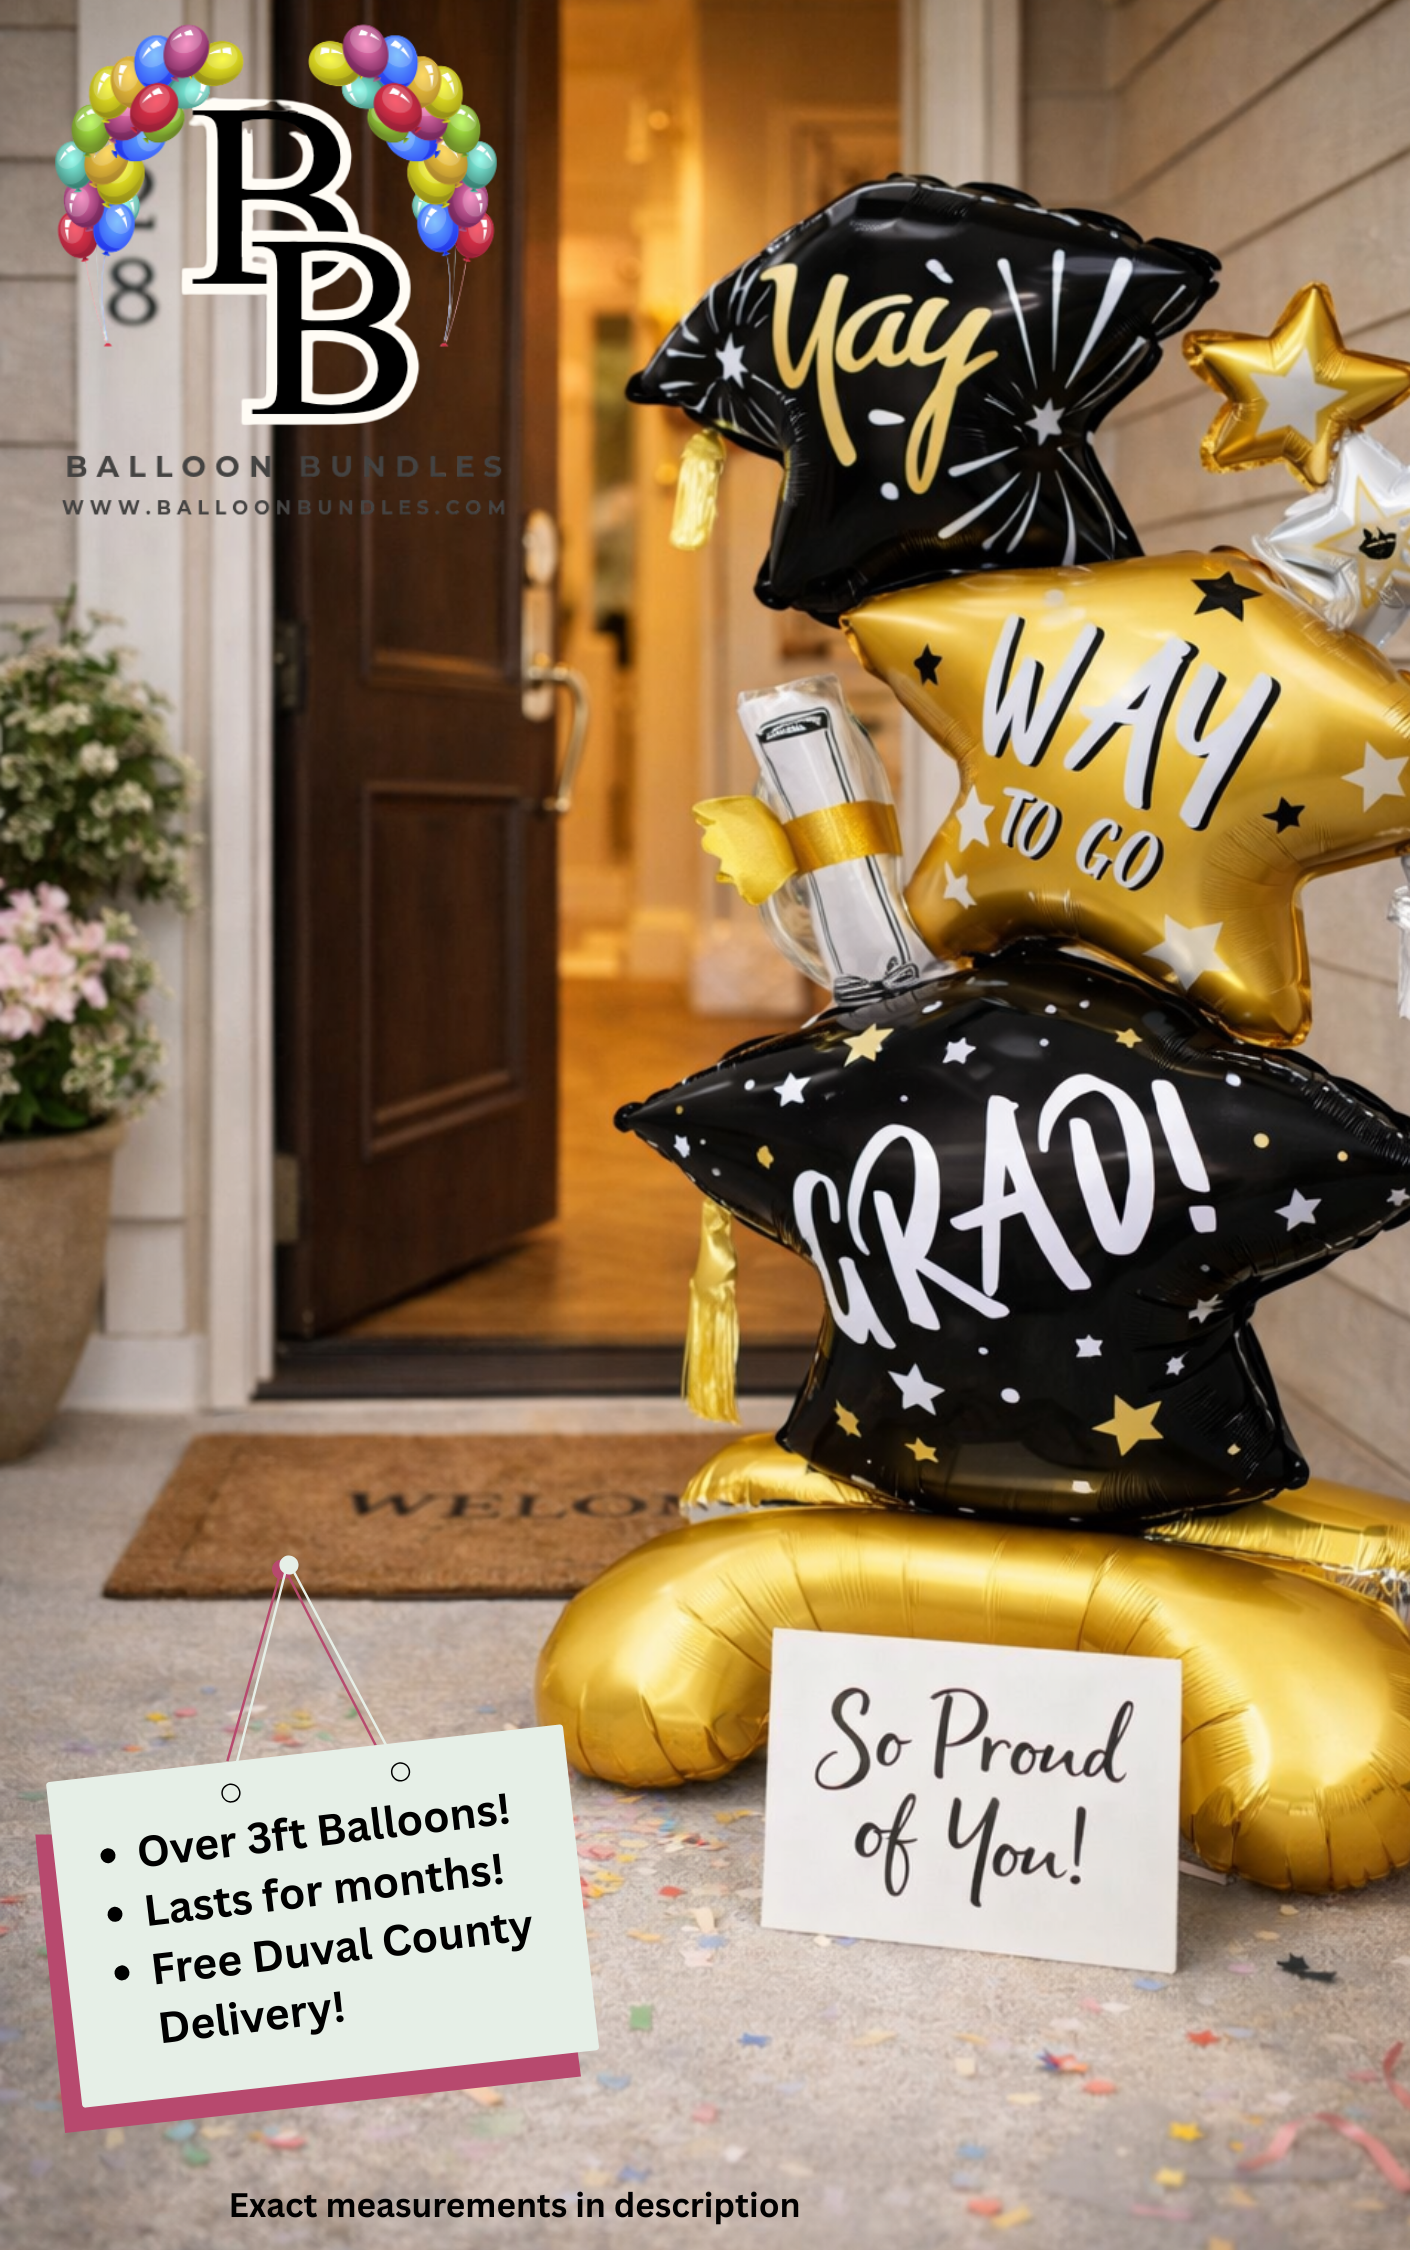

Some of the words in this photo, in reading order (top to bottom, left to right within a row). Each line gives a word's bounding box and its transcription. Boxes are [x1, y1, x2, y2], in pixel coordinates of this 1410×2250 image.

[761, 262, 998, 495] Yay
[982, 613, 1282, 832] WAY
[1001, 786, 1063, 861] TO
[1075, 817, 1164, 891] GO
[792, 1073, 1218, 1351] GRAD!
[814, 1687, 912, 1791] So
[930, 1687, 1134, 1784] Proud
[854, 1792, 918, 1897] of
[947, 1796, 1087, 1908] You!
